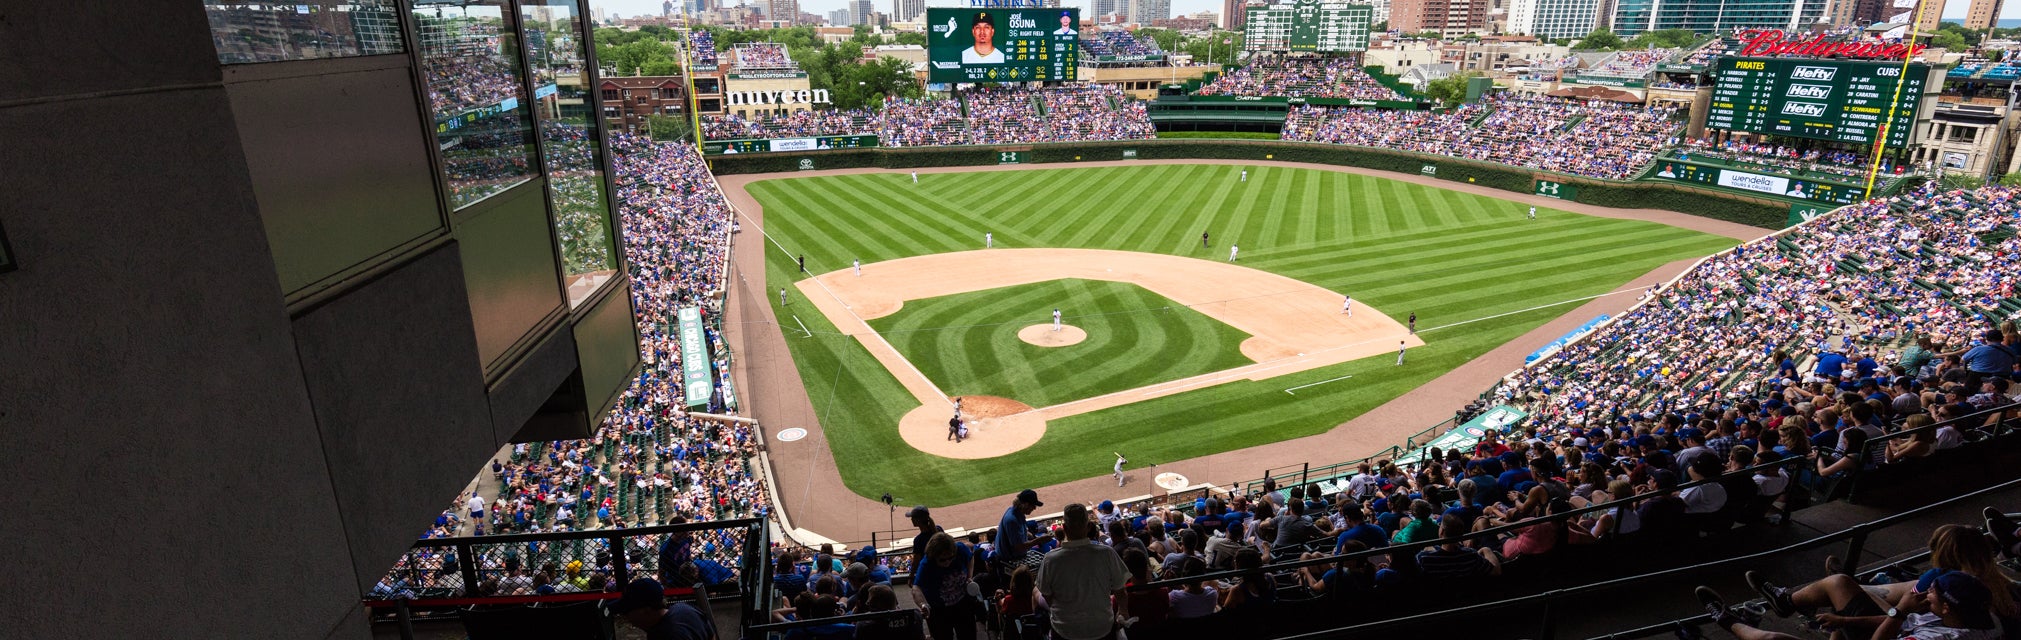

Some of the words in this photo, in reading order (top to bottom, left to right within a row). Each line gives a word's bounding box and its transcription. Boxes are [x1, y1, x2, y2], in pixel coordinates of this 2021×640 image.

[1010, 20, 1036, 28] OSUNA
[1740, 29, 1926, 59] Budweiser
[1736, 61, 1765, 70] PIRATES
[1877, 67, 1900, 76] CUBS
[1794, 67, 1832, 80] Hefty
[725, 88, 830, 105] nuveen
[1789, 86, 1827, 98] Hefty
[1785, 103, 1823, 116] Hefty
[1732, 175, 1770, 186] wendella
[687, 353, 703, 371] CUBS
